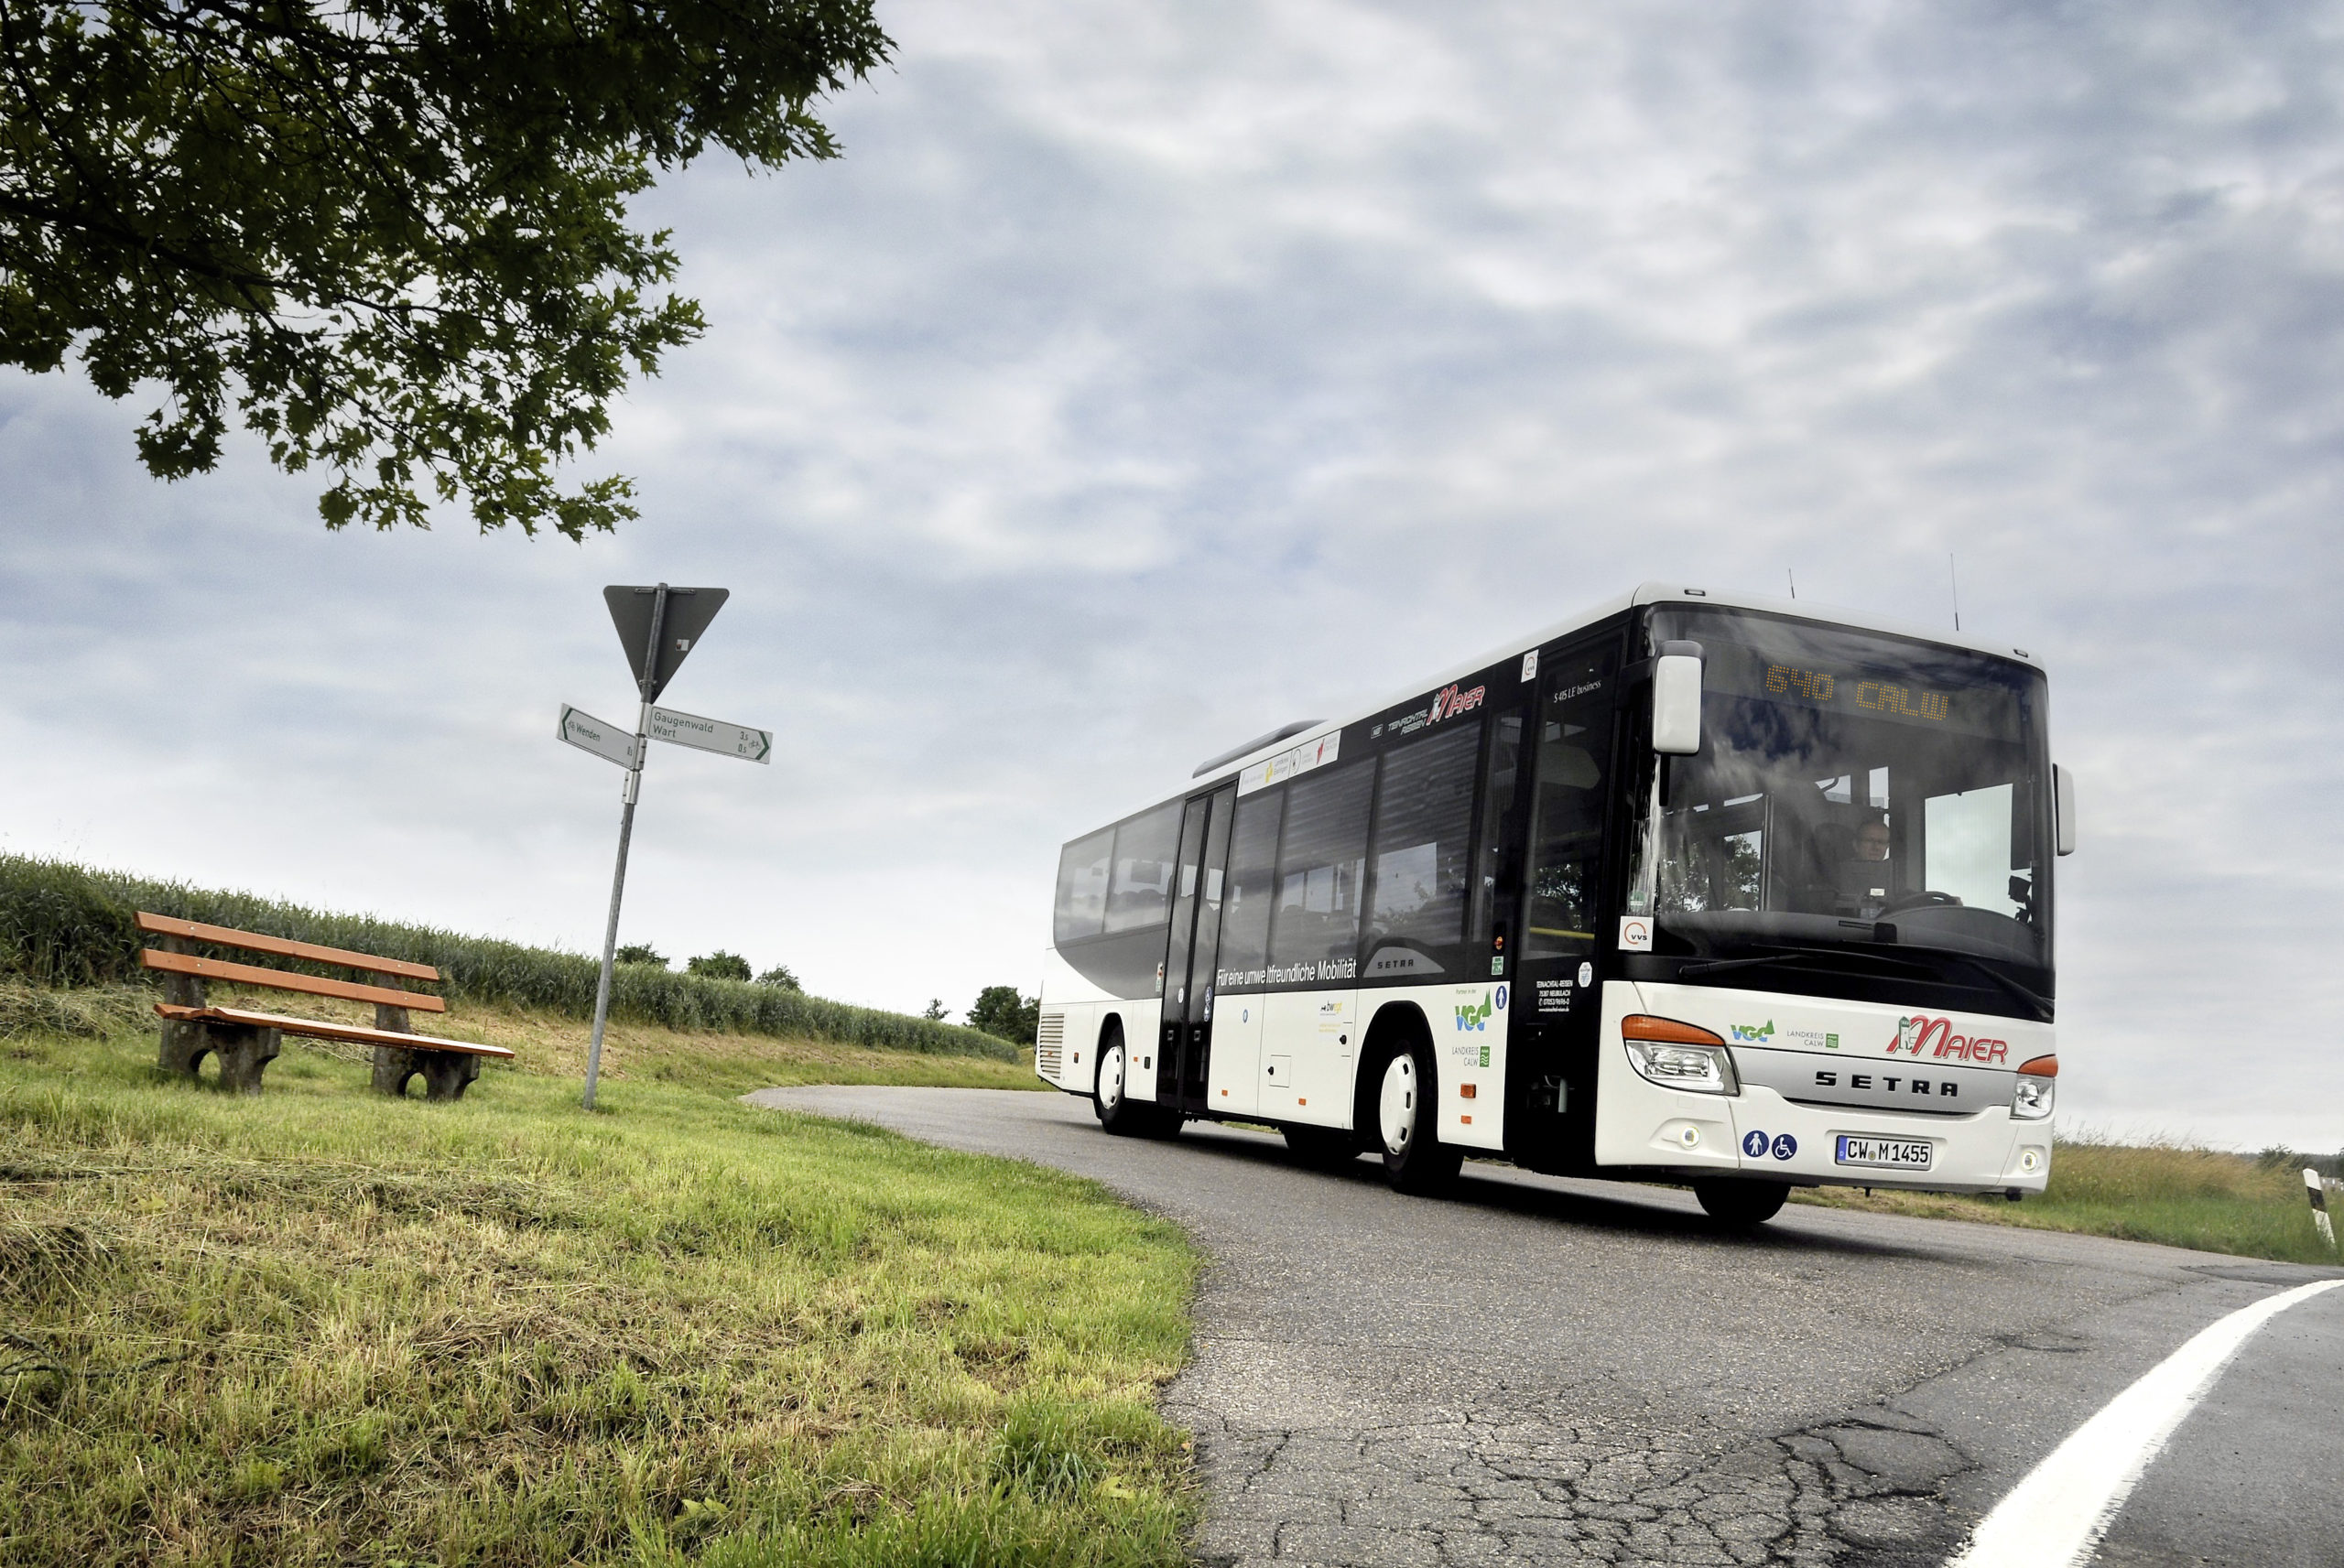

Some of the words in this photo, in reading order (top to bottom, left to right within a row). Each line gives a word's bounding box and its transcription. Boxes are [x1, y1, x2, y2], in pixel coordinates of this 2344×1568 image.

[1554, 693, 1558, 703] S
[1568, 686, 1577, 698] LE
[1577, 679, 1601, 695] business
[1765, 665, 1834, 701] 640
[1856, 681, 1948, 720] CALW
[1426, 684, 1485, 726] MAIER
[576, 723, 601, 741] Wenden
[653, 724, 676, 738] Wart
[654, 711, 714, 733] Gaugenwald
[1217, 968, 1229, 987] Für
[1228, 968, 1243, 986] eine
[1317, 957, 1356, 981] Mobilität
[1377, 959, 1414, 969] SETRA
[1786, 1030, 1824, 1040] LANDKREIS
[1804, 1039, 1824, 1047] CALW
[1886, 1014, 2009, 1065] MAIER
[1452, 1046, 1479, 1055] LANDKREIS
[1464, 1058, 1479, 1067] CALW
[1815, 1071, 1958, 1098] SETRA
[1848, 1141, 1869, 1160] CW
[1878, 1142, 1889, 1161] M
[1892, 1143, 1929, 1163] 1455
